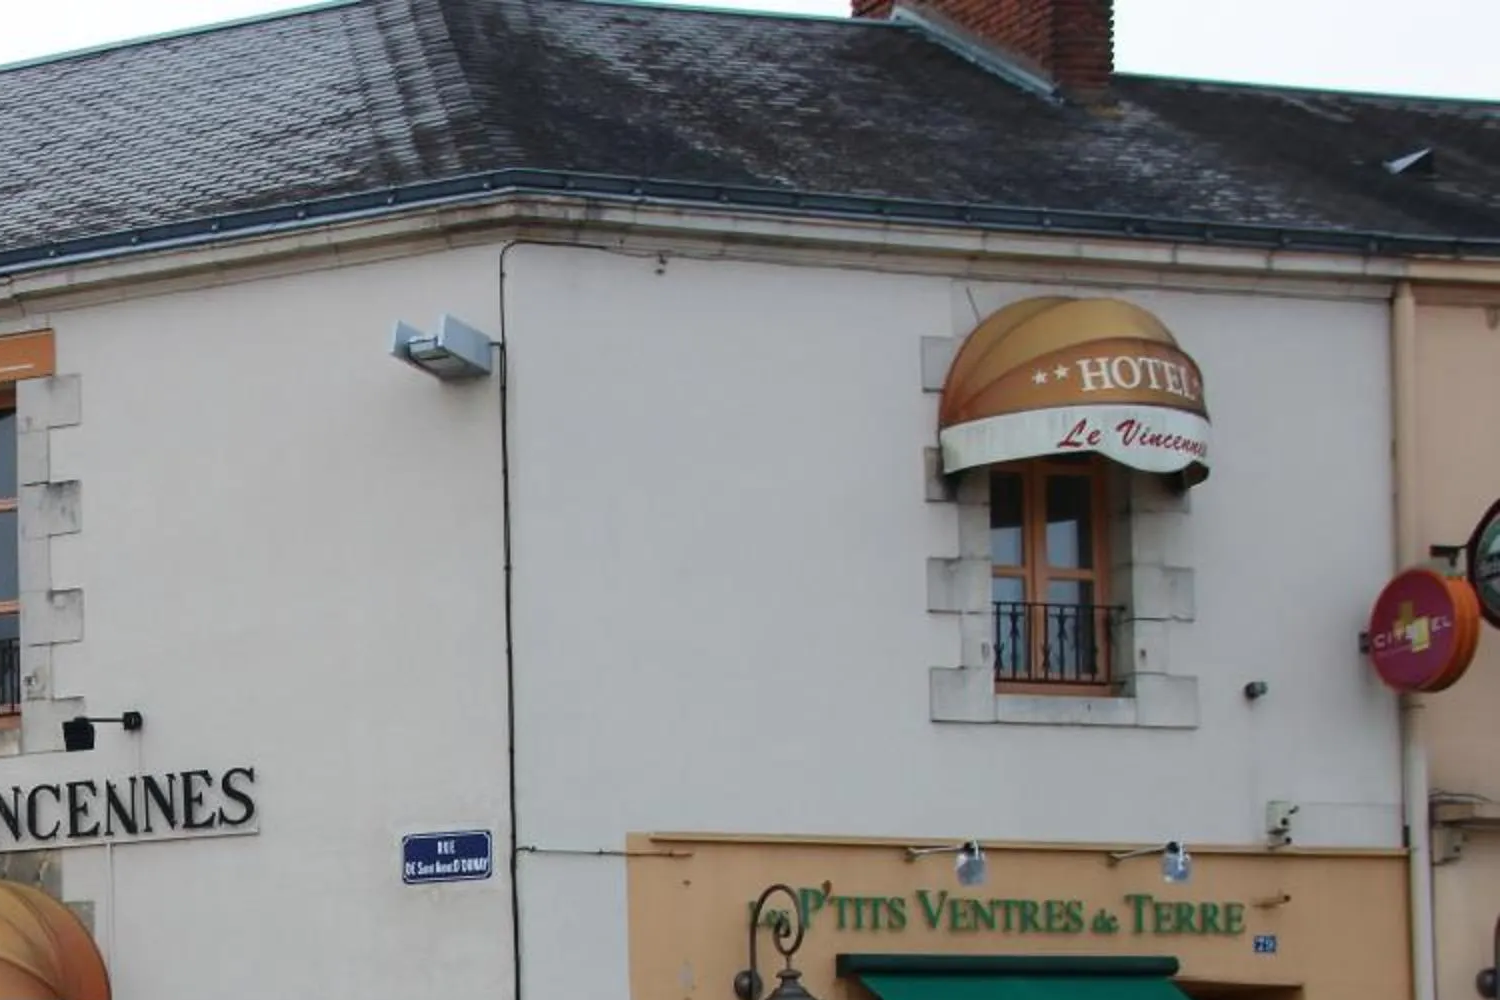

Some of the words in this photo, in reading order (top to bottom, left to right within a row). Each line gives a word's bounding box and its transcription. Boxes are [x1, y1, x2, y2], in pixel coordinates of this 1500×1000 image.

[1075, 355, 1197, 401] HOTEL
[1057, 417, 1101, 449] Le
[1114, 418, 1207, 459] Vincenn
